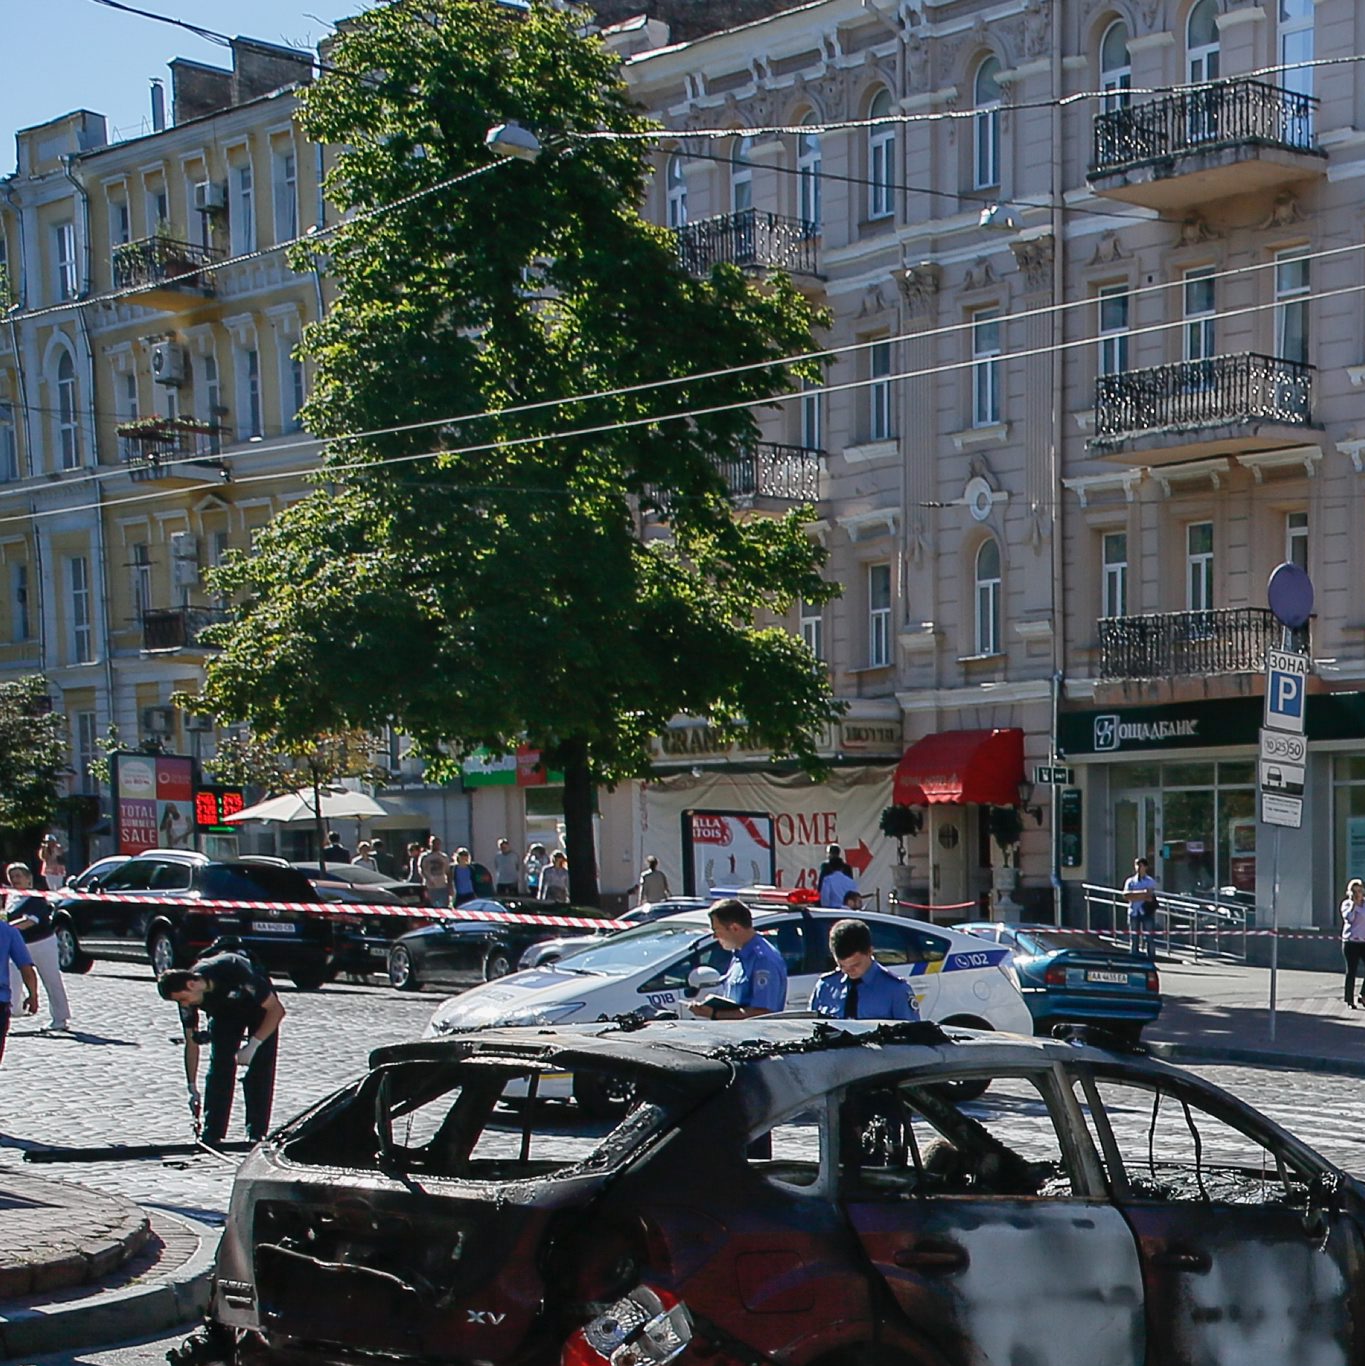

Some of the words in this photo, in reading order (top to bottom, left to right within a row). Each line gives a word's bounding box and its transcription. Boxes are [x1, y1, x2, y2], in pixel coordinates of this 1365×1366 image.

[1270, 654, 1305, 674] ЗОНА
[1278, 676, 1297, 712] P
[1288, 743, 1301, 756] 50
[121, 805, 155, 818] TOTAL
[121, 818, 156, 828] SUMMER
[122, 828, 156, 844] SALE
[968, 953, 990, 966] 102
[467, 1310, 506, 1325] XV
